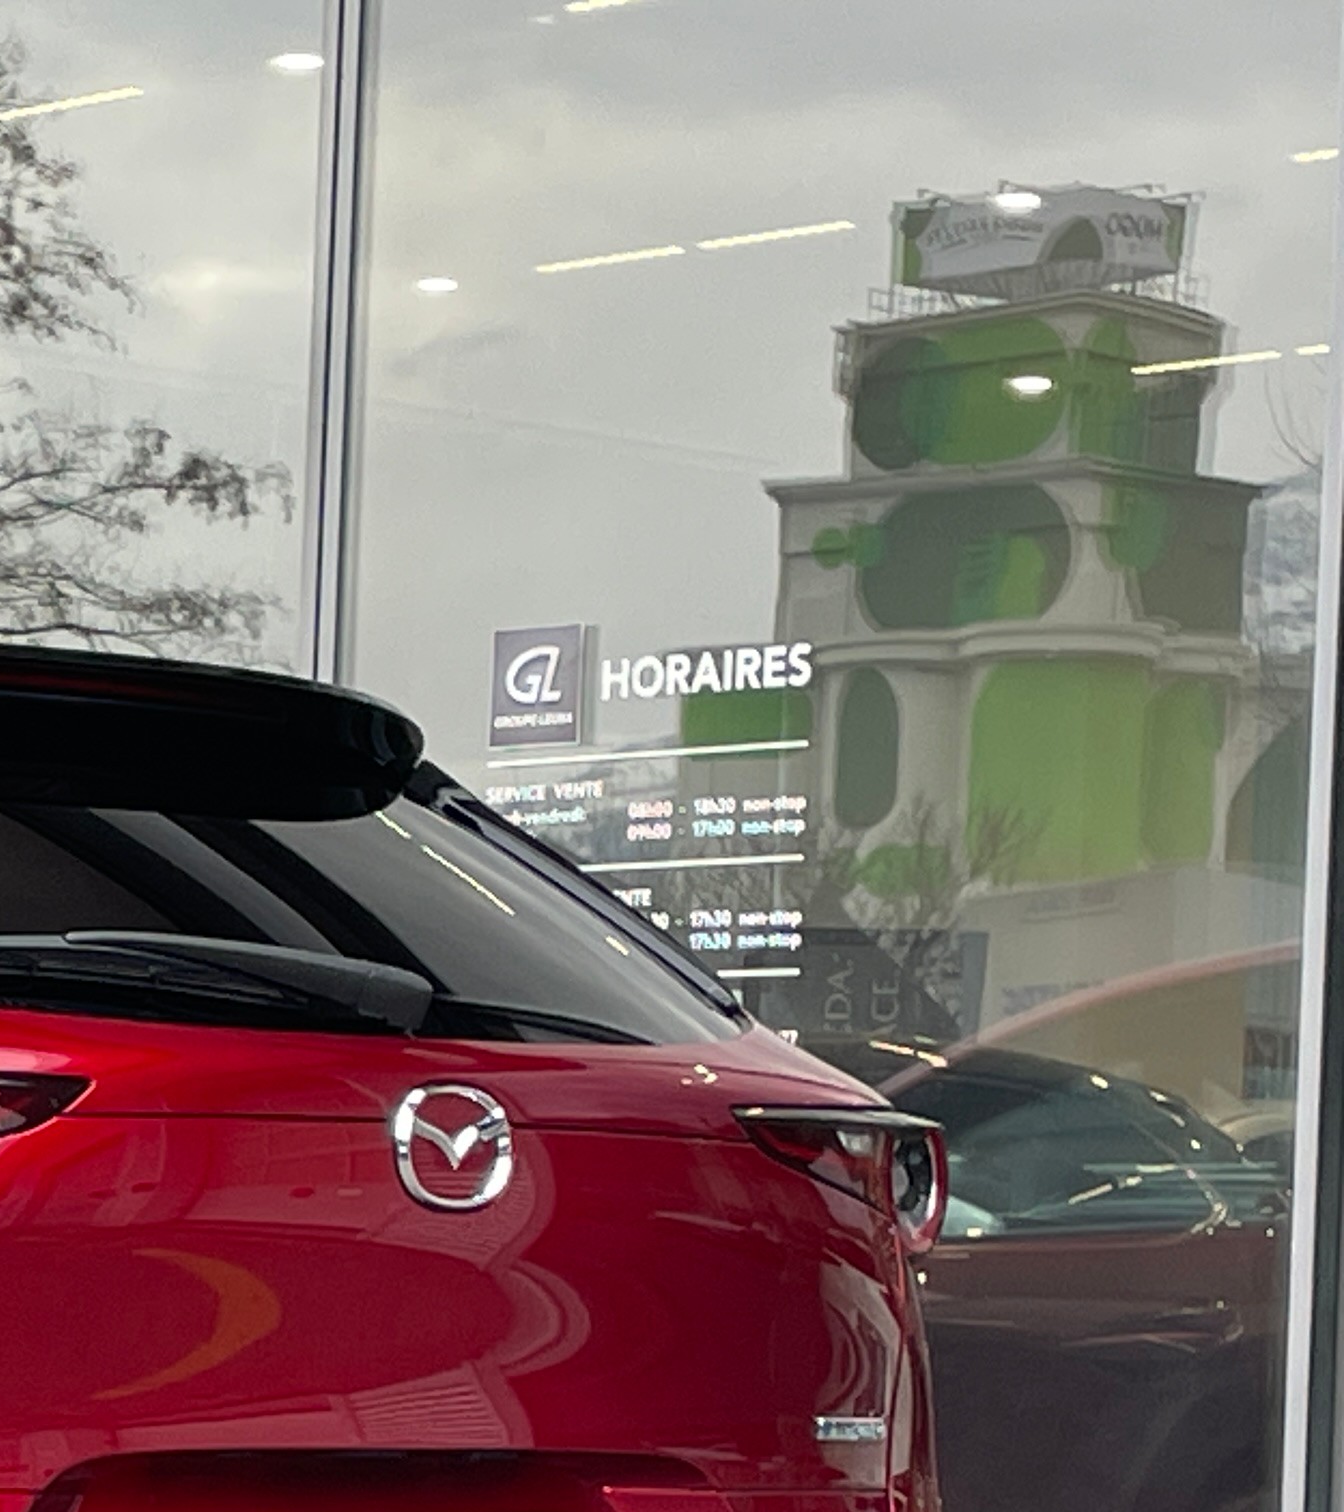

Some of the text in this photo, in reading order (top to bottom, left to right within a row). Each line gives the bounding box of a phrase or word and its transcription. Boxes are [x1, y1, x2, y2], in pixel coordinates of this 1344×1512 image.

[505, 645, 562, 704] GL
[600, 643, 812, 700] HORAIRES
[553, 779, 604, 799] VENTE
